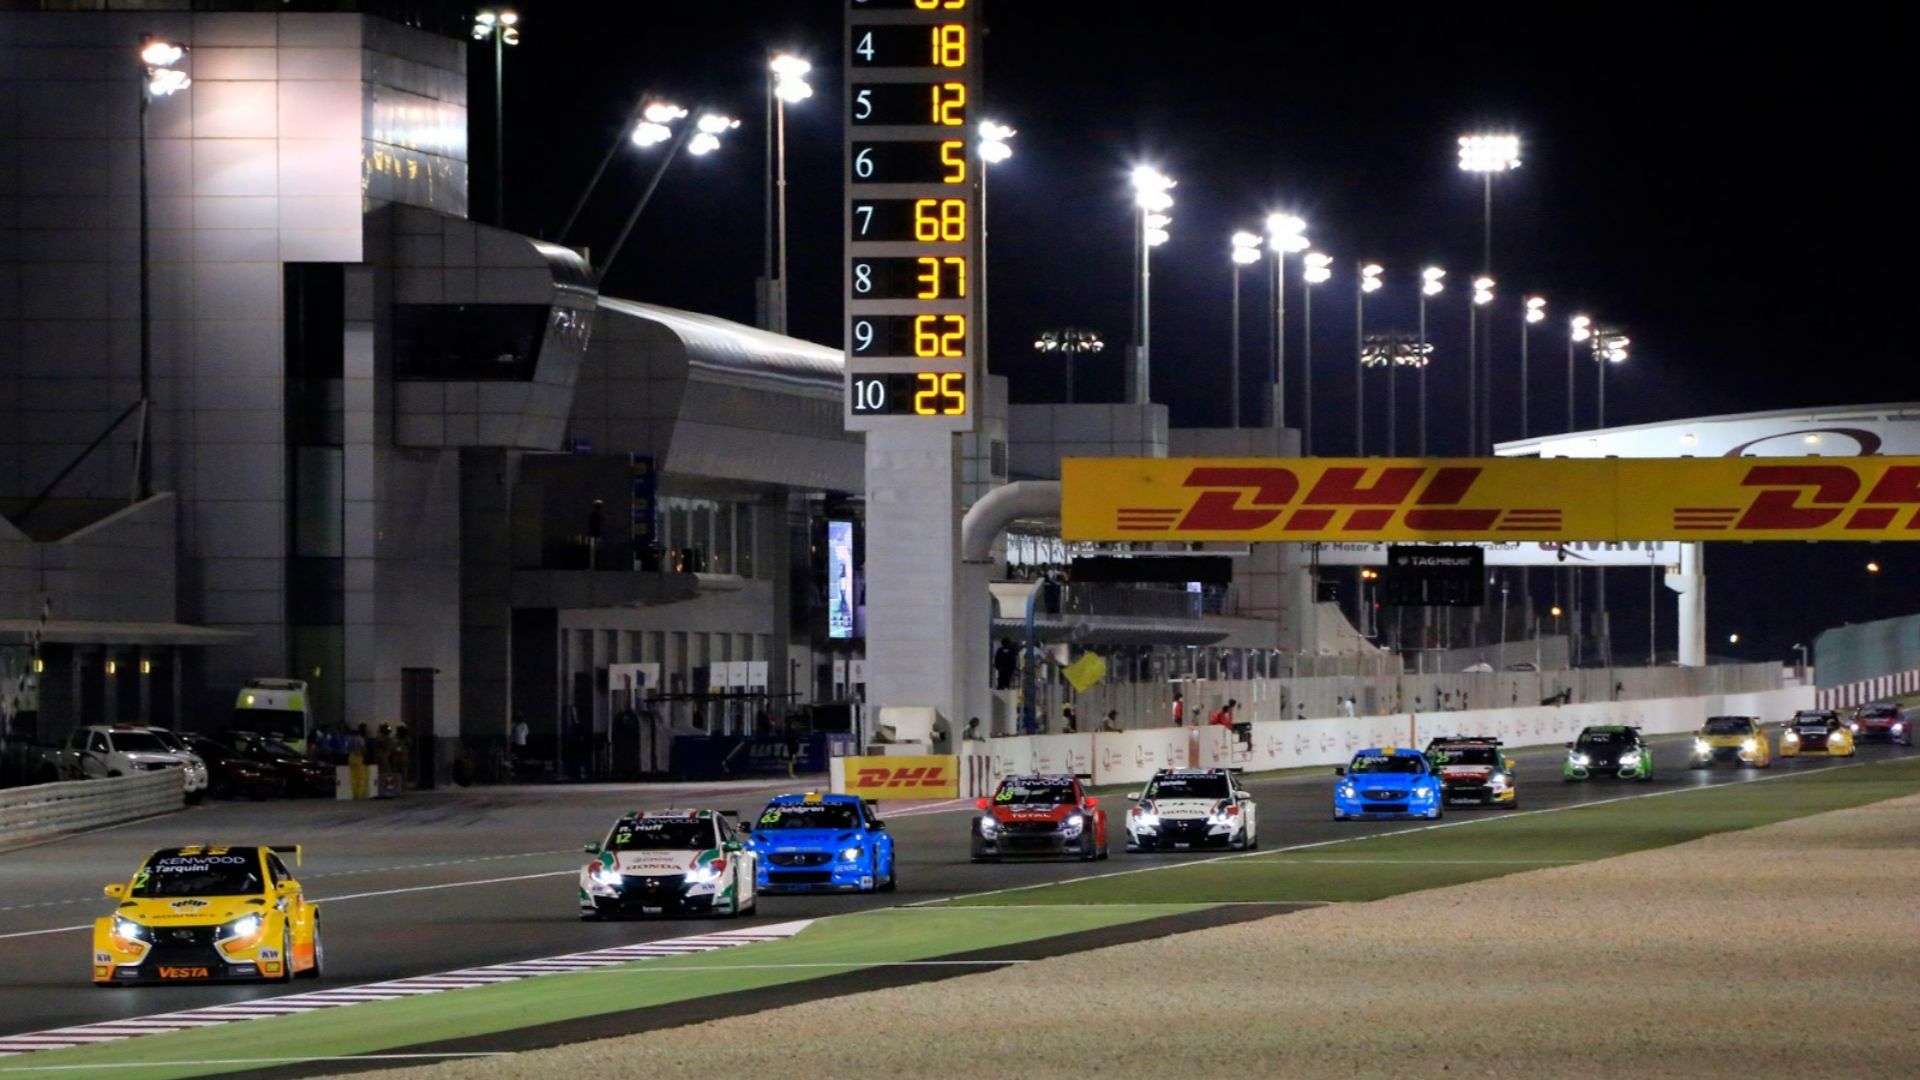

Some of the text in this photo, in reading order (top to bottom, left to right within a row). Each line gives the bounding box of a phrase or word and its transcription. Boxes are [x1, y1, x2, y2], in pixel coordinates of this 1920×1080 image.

[855, 24, 965, 67] 4 18
[855, 83, 965, 125] 5 12
[855, 141, 965, 183] 6 5
[856, 199, 966, 241] 7 68
[855, 257, 966, 299] 8 37
[855, 315, 966, 357] 9 62
[855, 373, 966, 415] 10 25
[1175, 467, 1500, 531] DHL
[857, 768, 947, 788] DHL
[616, 832, 632, 844] 12
[635, 823, 664, 832] Huff
[155, 863, 210, 874] Tarquini
[158, 855, 246, 866] KENWOOD
[626, 863, 683, 871] HONDA
[134, 872, 150, 889] 2
[158, 966, 209, 978] VESTA
